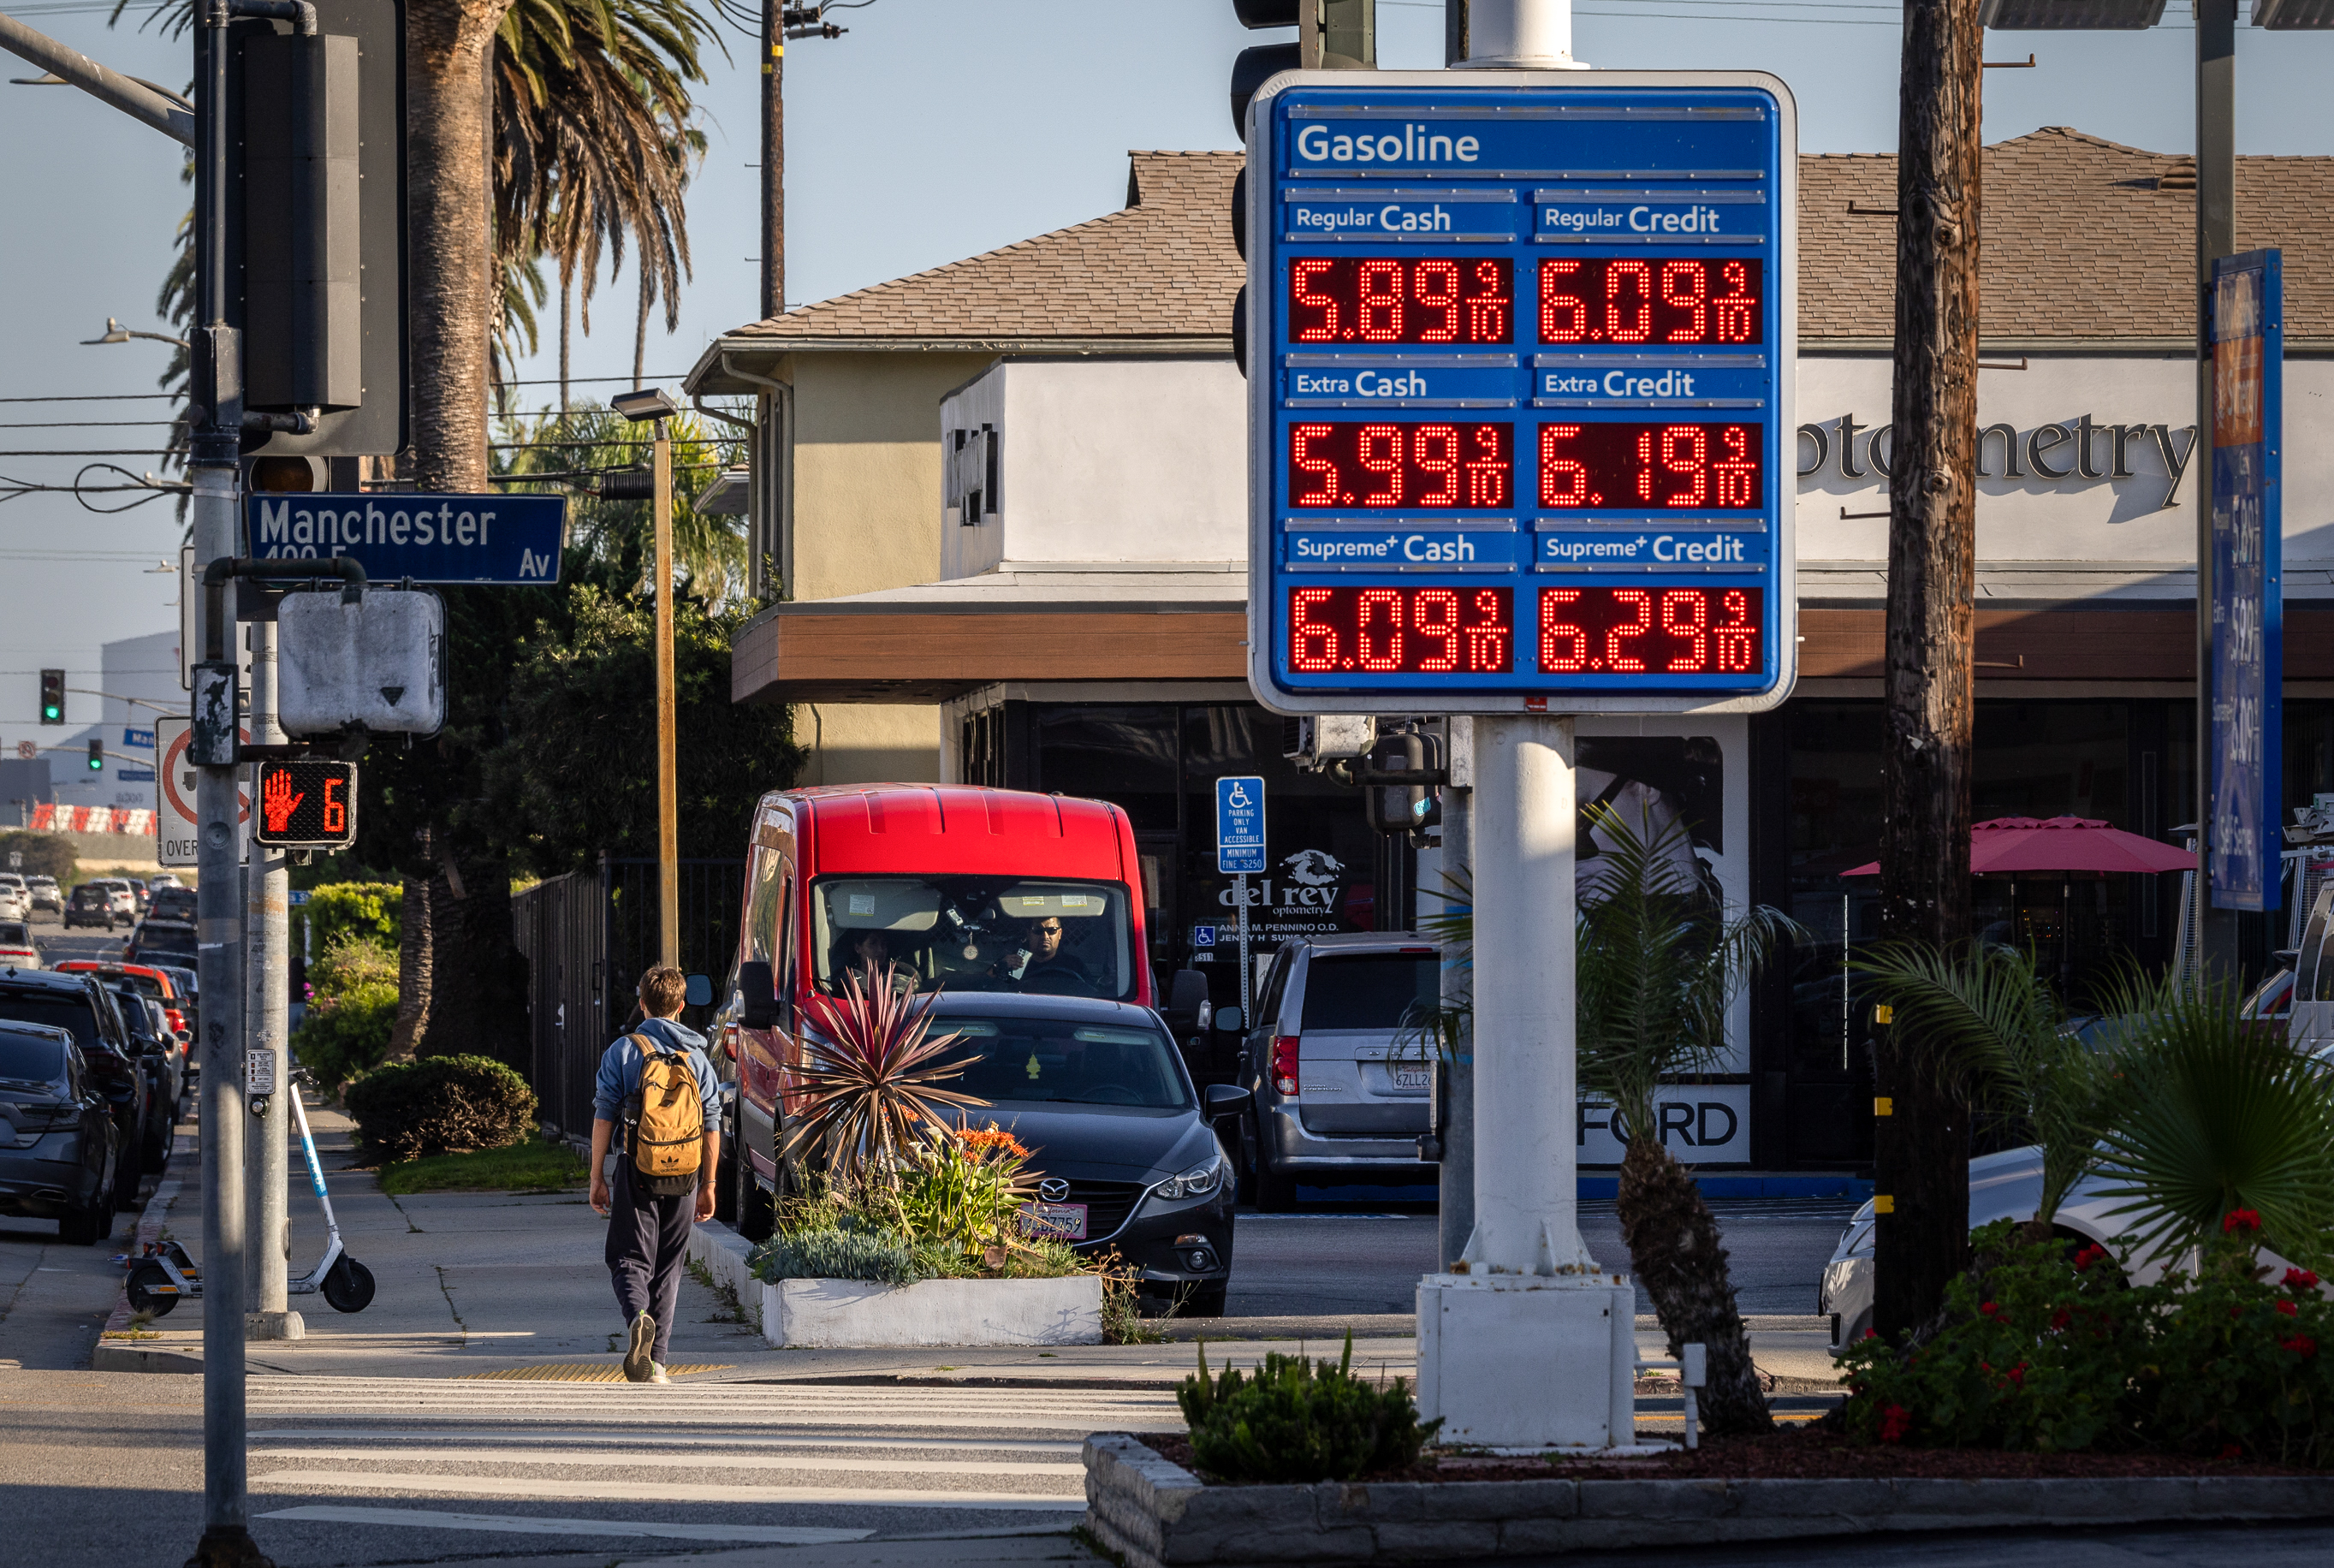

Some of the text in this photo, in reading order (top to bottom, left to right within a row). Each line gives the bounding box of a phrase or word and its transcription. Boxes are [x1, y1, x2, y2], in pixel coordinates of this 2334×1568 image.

[1298, 123, 1480, 162] Gasoline
[1297, 205, 1451, 231] Regular Cash
[1546, 206, 1719, 232] Regular Credit
[1294, 260, 1458, 341] 5.89
[1541, 260, 1706, 341] 6.09
[1297, 370, 1427, 395] Extra Cash
[1546, 370, 1695, 396] Extra Credit
[1294, 425, 1458, 506] 5.99
[1541, 425, 1706, 506] 6.19
[260, 500, 496, 545] Manchester
[1404, 534, 1475, 561] Cash
[1653, 534, 1744, 561] Credit
[519, 548, 549, 577] Av
[1294, 590, 1458, 670] 6.09
[1541, 590, 1706, 670] 6.29
[324, 778, 344, 832] 6
[1228, 809, 1255, 817] PARKING
[1224, 835, 1260, 844] ACCESSIBLE
[1226, 848, 1257, 858] MINIMUM
[1222, 860, 1238, 869] FINE
[1218, 879, 1339, 914] del rey
[1273, 905, 1326, 918] optometry
[1317, 923, 1339, 931] O.D.
